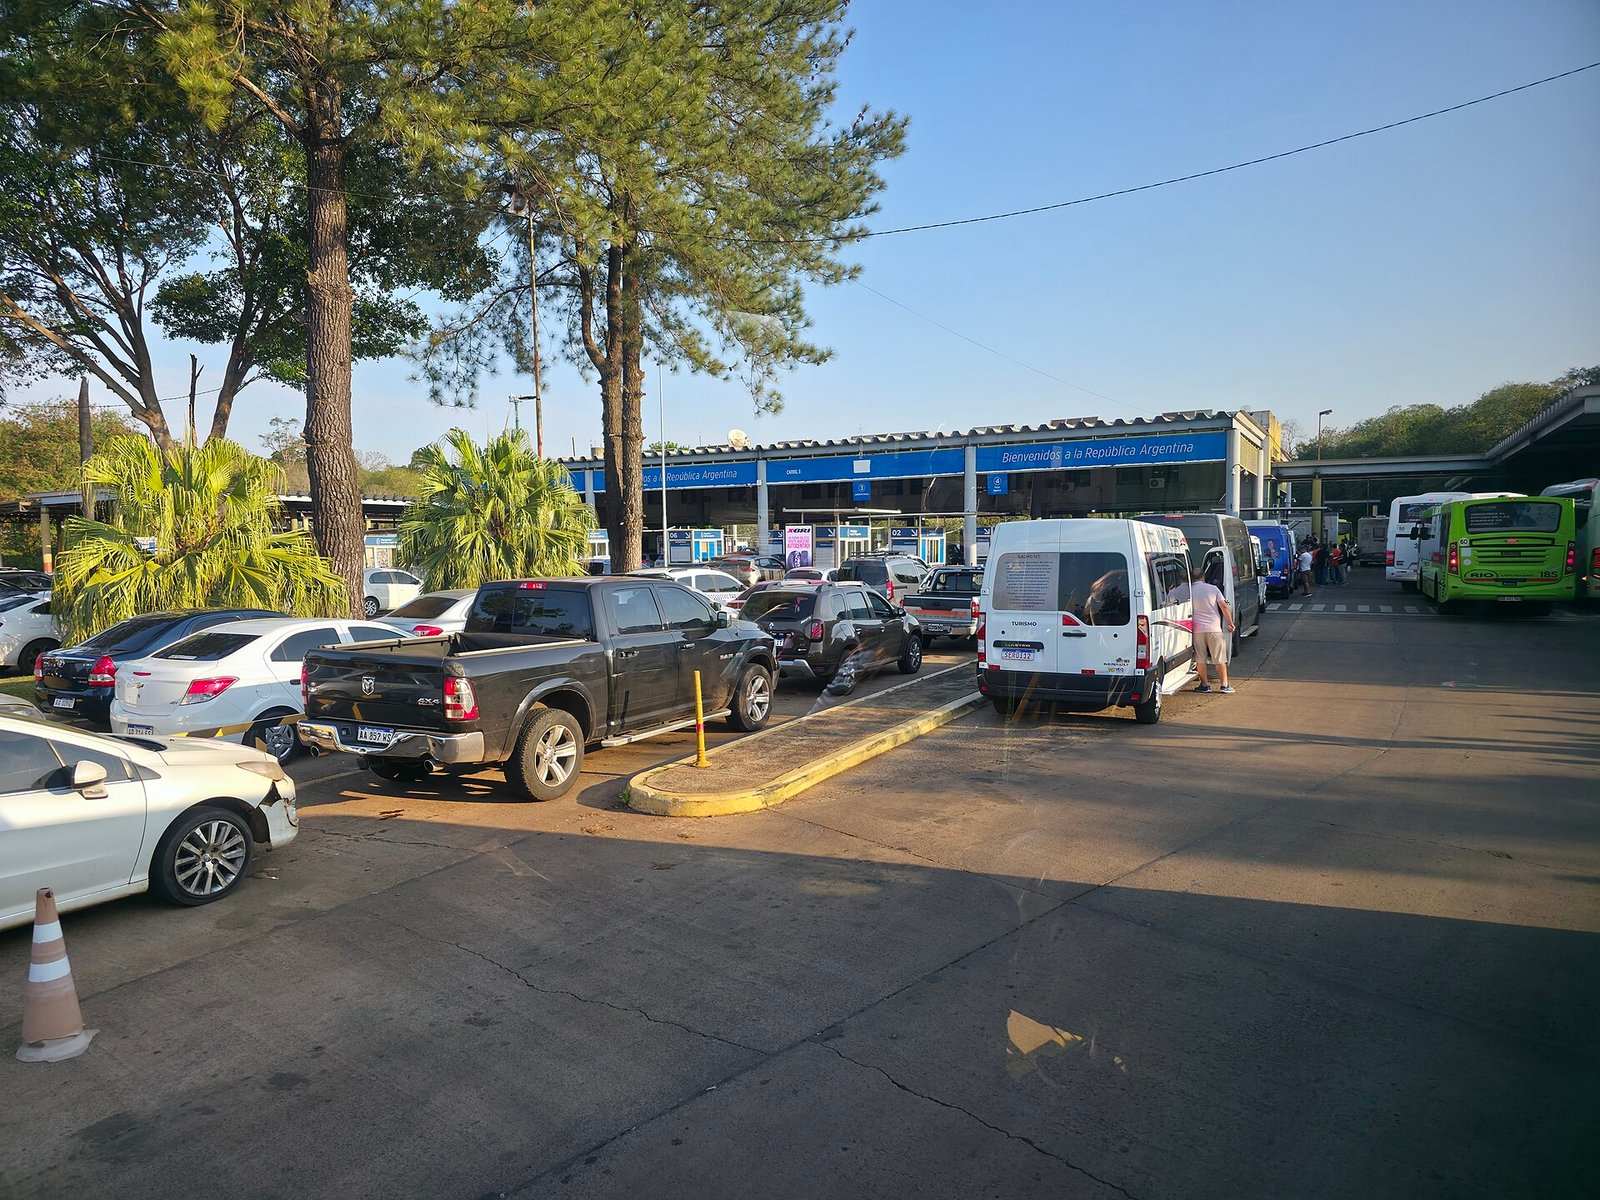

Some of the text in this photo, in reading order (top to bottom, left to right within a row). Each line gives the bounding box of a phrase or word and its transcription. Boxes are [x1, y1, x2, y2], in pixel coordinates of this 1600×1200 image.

[1002, 442, 1194, 463] Bienvenidos a la República Argentina
[666, 470, 700, 482] República
[702, 468, 738, 480] Argentina
[360, 730, 368, 740] AA
